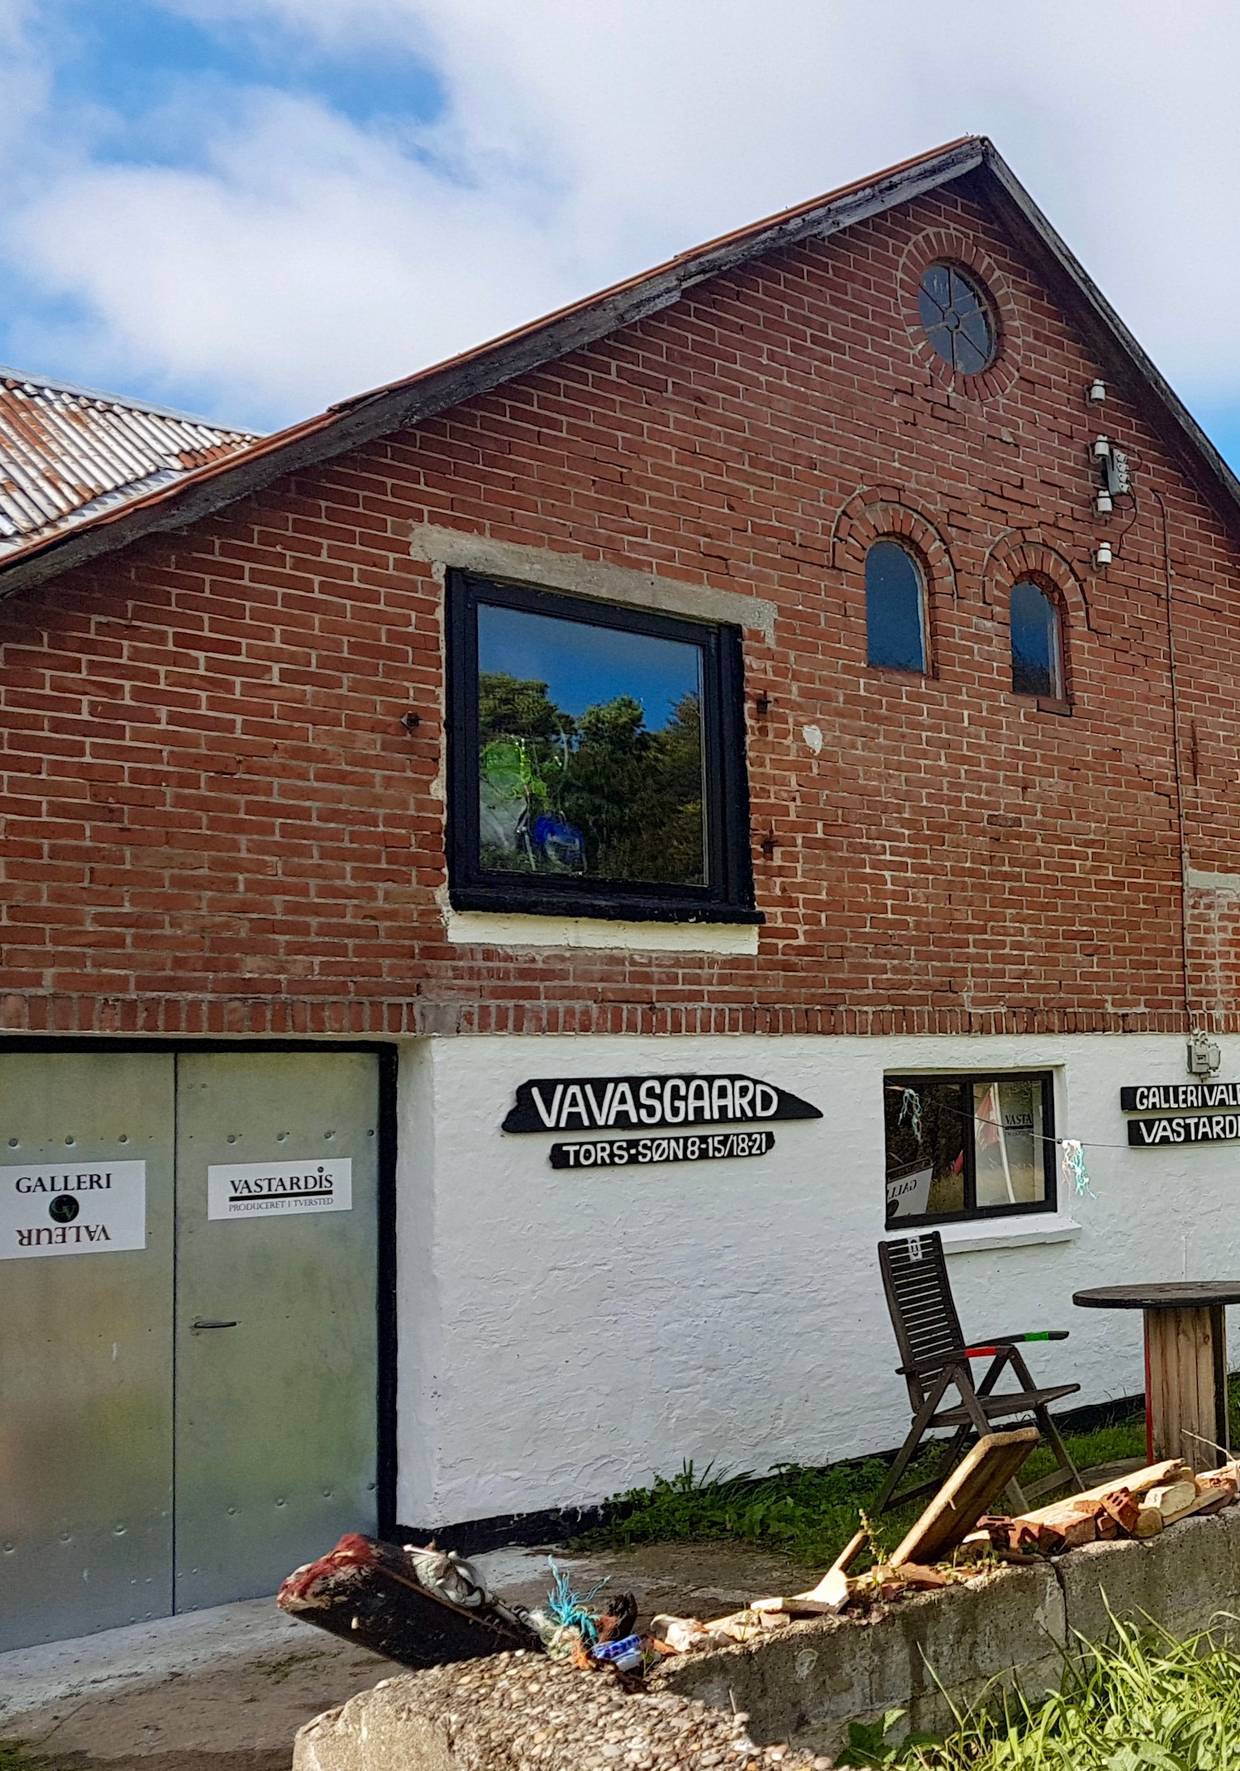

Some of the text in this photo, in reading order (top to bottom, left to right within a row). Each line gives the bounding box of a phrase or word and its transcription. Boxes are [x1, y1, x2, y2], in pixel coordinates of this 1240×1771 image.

[531, 1077, 779, 1128] VAVASGAARD
[1136, 1085, 1202, 1109] GALLERI
[562, 1133, 766, 1166] TORS-SØN 8-15/18-21
[15, 1173, 112, 1195] GALLERI
[229, 1167, 333, 1195] VASTARDIS
[229, 1200, 285, 1212] PRODUCERET
[293, 1198, 334, 1208] TVERSTED
[17, 1224, 112, 1247] VALEUR
